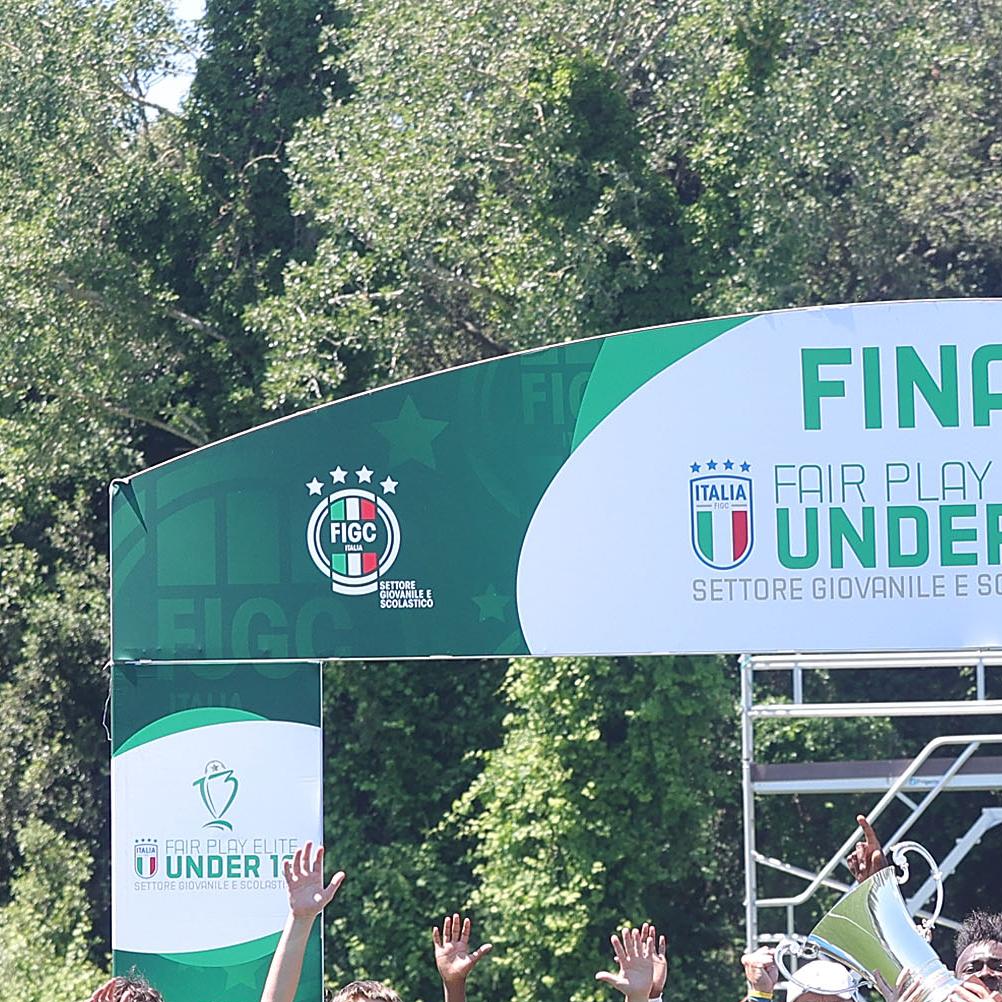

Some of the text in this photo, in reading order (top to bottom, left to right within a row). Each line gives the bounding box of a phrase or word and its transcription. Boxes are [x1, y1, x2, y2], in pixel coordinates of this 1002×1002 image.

[775, 464, 865, 504] FAIR
[886, 461, 992, 502] PLAY
[696, 484, 747, 501] ITALIA
[330, 522, 377, 543] FIGC
[379, 580, 416, 590] SETTORE
[693, 577, 803, 601] SETTORE
[812, 575, 945, 600] GIOVANILE
[955, 574, 968, 597] E
[379, 589, 432, 599] GIOVANILE E
[380, 599, 434, 609] SCOLASTICO
[165, 838, 298, 855] FAIR PLAY ELITE
[166, 855, 260, 879] UNDER
[134, 880, 287, 891] SETTORE GIOVANILE E SCOLASTI
